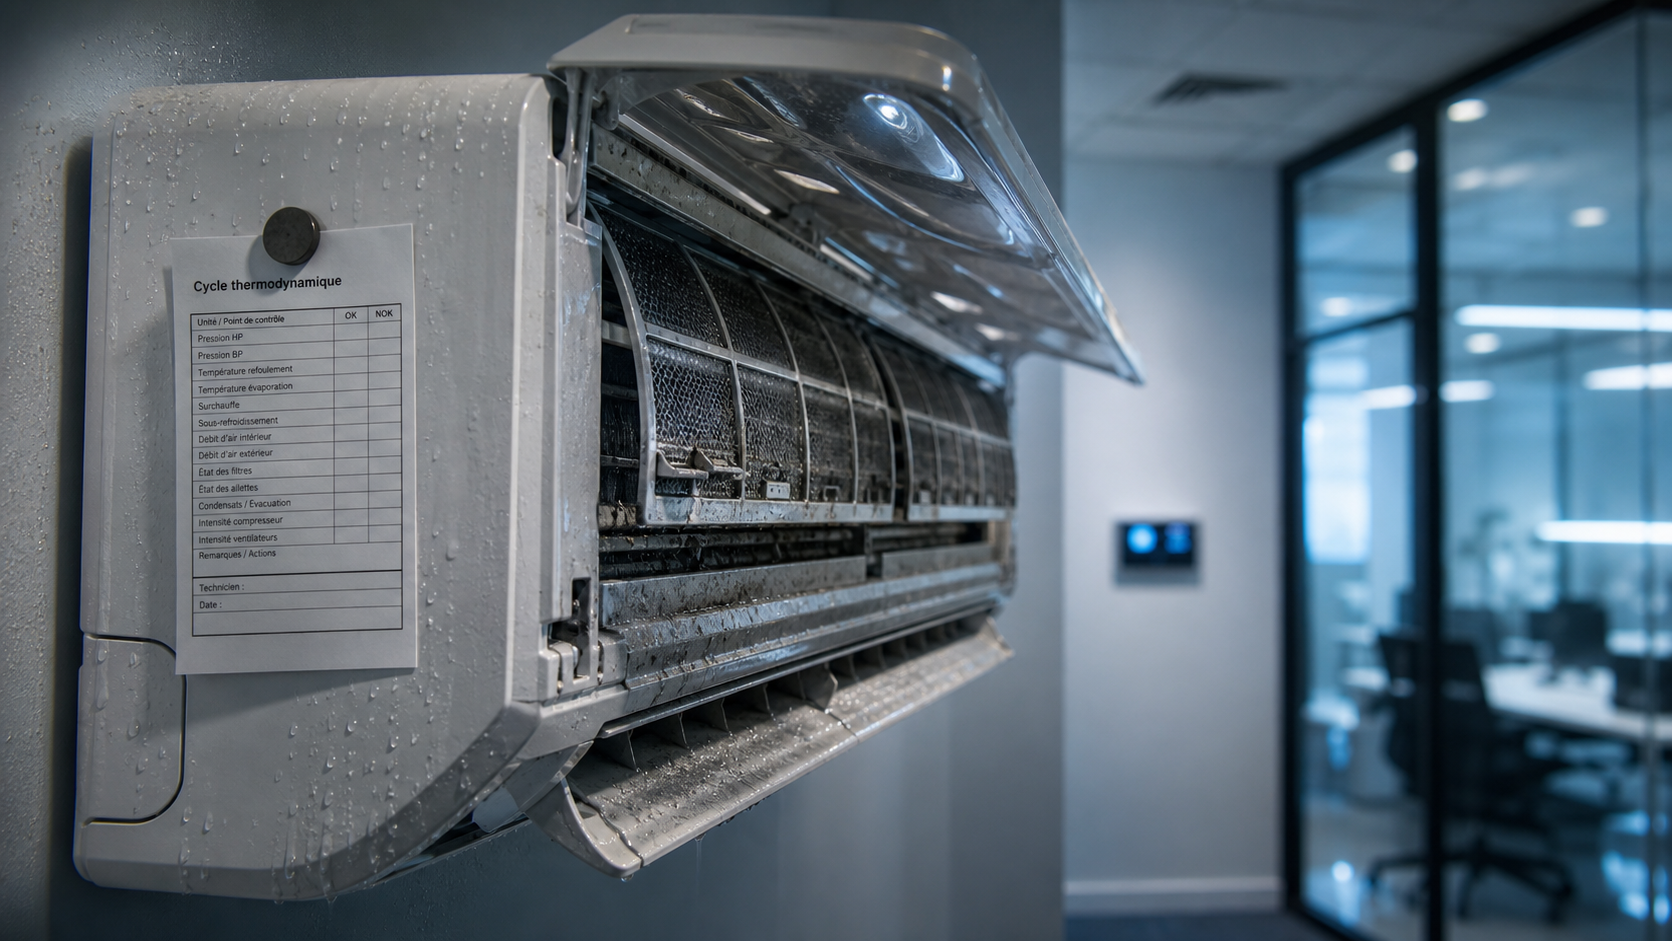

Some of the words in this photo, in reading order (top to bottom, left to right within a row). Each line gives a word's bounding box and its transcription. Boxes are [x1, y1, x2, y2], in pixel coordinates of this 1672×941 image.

[194, 280, 227, 294] Cycle
[231, 276, 342, 291] thermodynamique
[197, 318, 217, 326] Unité
[255, 315, 284, 323] contrôle
[198, 334, 230, 343] Pression
[198, 351, 230, 360] Pression
[198, 368, 246, 377] Température
[248, 365, 292, 374] refoulement
[198, 385, 246, 394] Température
[248, 382, 293, 392] évaporation
[198, 401, 240, 410] Surchauffe
[239, 449, 273, 457] extérieur
[216, 468, 229, 476] des
[231, 467, 252, 475] filtres
[216, 484, 229, 493] des
[231, 484, 258, 492] ailettes
[198, 501, 242, 510] Condensats
[199, 518, 231, 527] Intensité
[233, 516, 283, 526] compresseur
[199, 535, 231, 544] Intensité
[199, 551, 242, 560] Remarques
[249, 549, 276, 558] Actions
[200, 583, 240, 592] Technicien
[200, 601, 217, 609] Date
